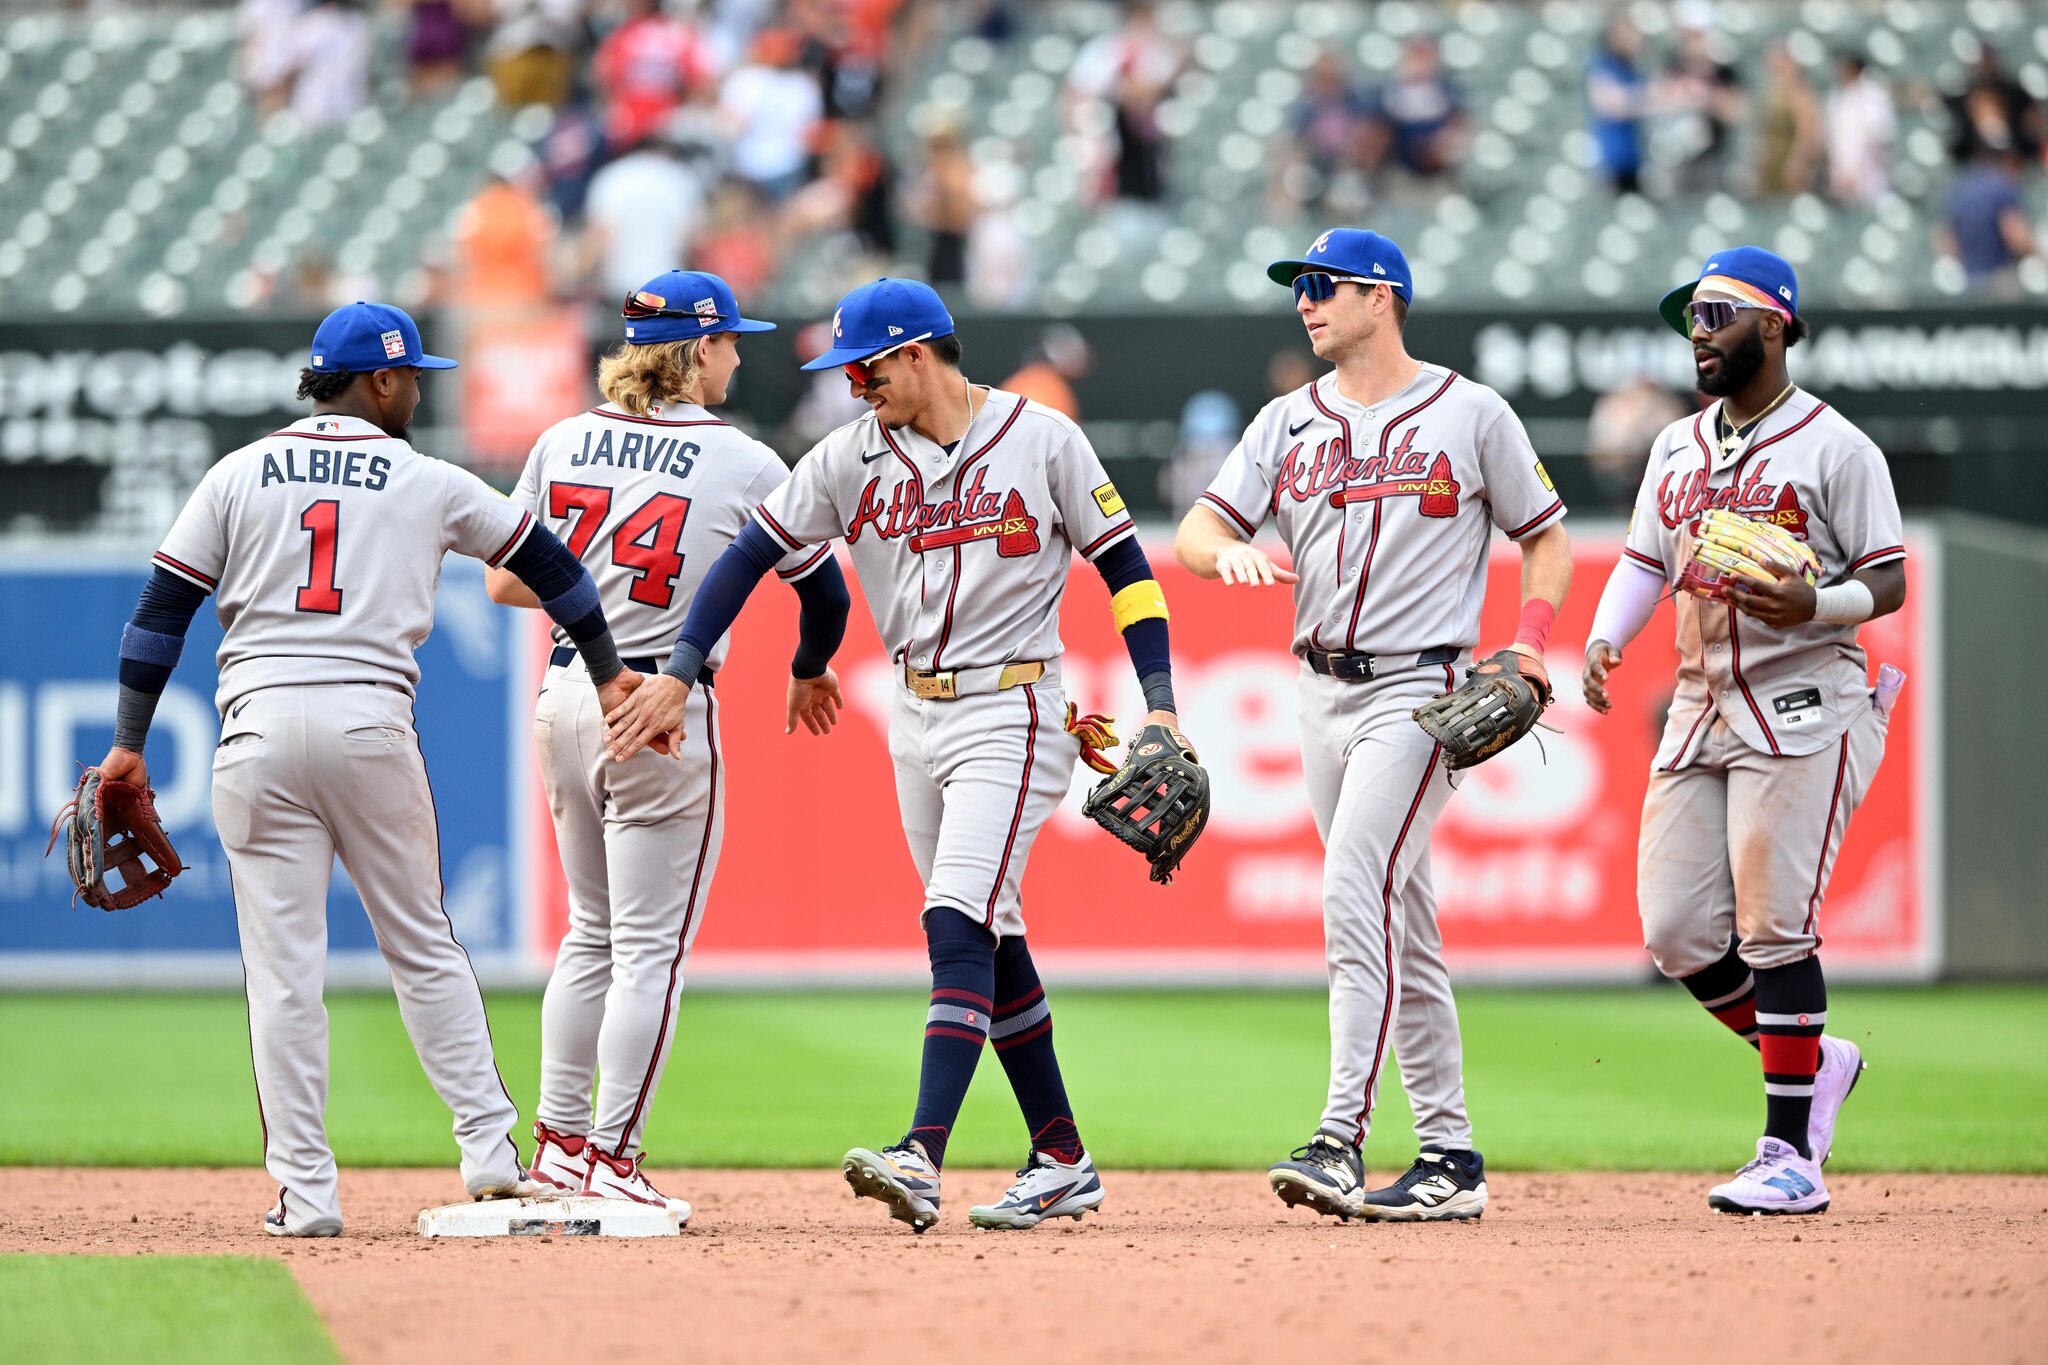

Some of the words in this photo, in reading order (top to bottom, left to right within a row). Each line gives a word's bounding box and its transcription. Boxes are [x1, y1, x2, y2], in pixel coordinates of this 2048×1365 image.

[261, 448, 392, 491] ALBIES
[570, 429, 701, 479] JARVIS
[1271, 425, 1429, 516] Atlanta
[845, 464, 1002, 544] Atlanta
[1657, 457, 1778, 531] Atlanta
[294, 498, 344, 616] 1
[549, 480, 692, 610] 74
[940, 678, 950, 692] 14
[1170, 807, 1202, 850] Rawlings
